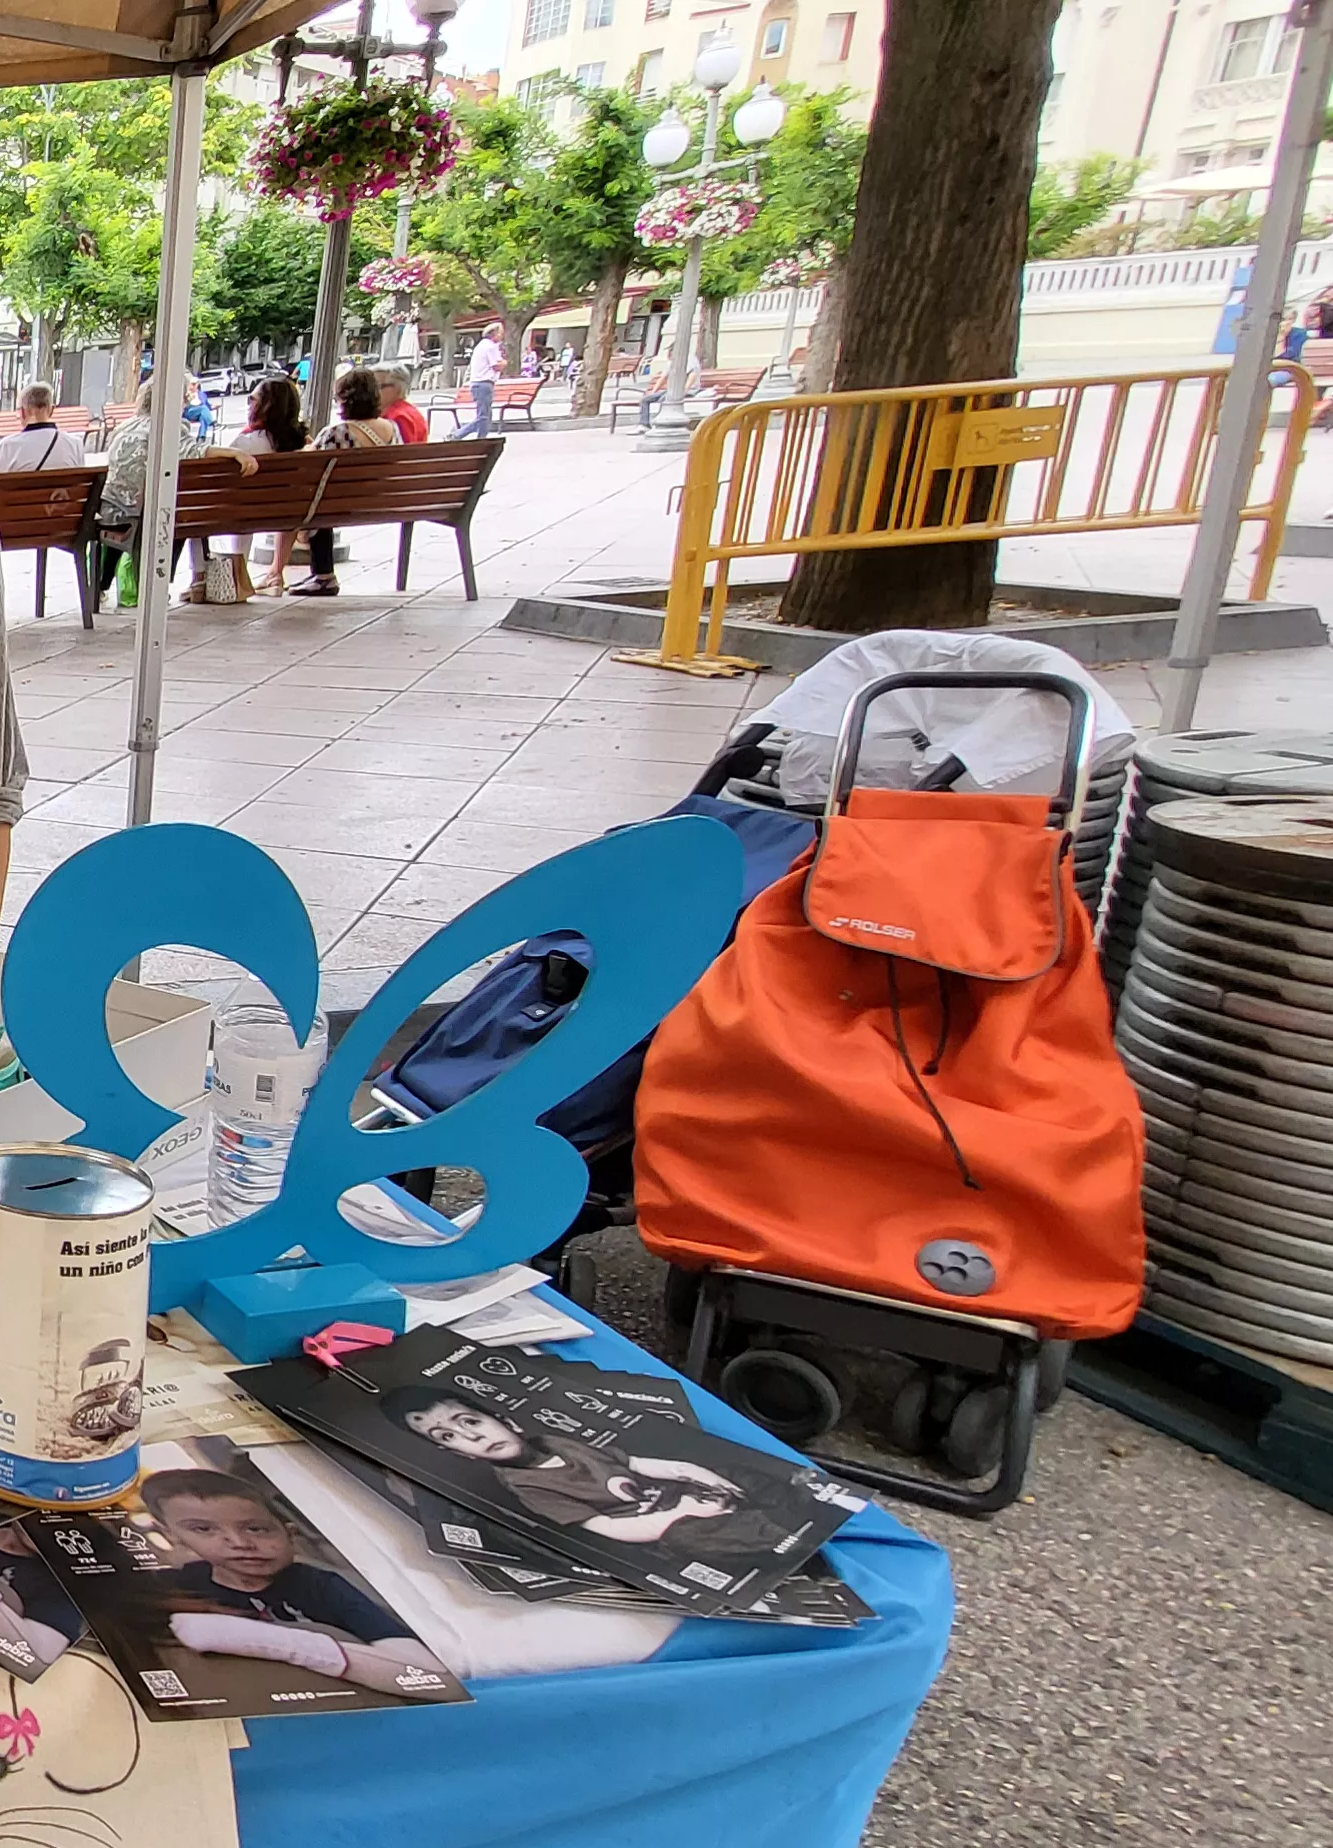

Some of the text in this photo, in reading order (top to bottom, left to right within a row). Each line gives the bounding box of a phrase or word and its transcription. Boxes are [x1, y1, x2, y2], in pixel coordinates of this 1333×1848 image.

[849, 918, 916, 940] ROLSER
[151, 1126, 202, 1160] GEOX
[60, 1240, 90, 1256] Así
[96, 1233, 138, 1256] siente
[60, 1265, 83, 1278] un
[89, 1260, 123, 1278] niño
[395, 1674, 442, 1686] debra
